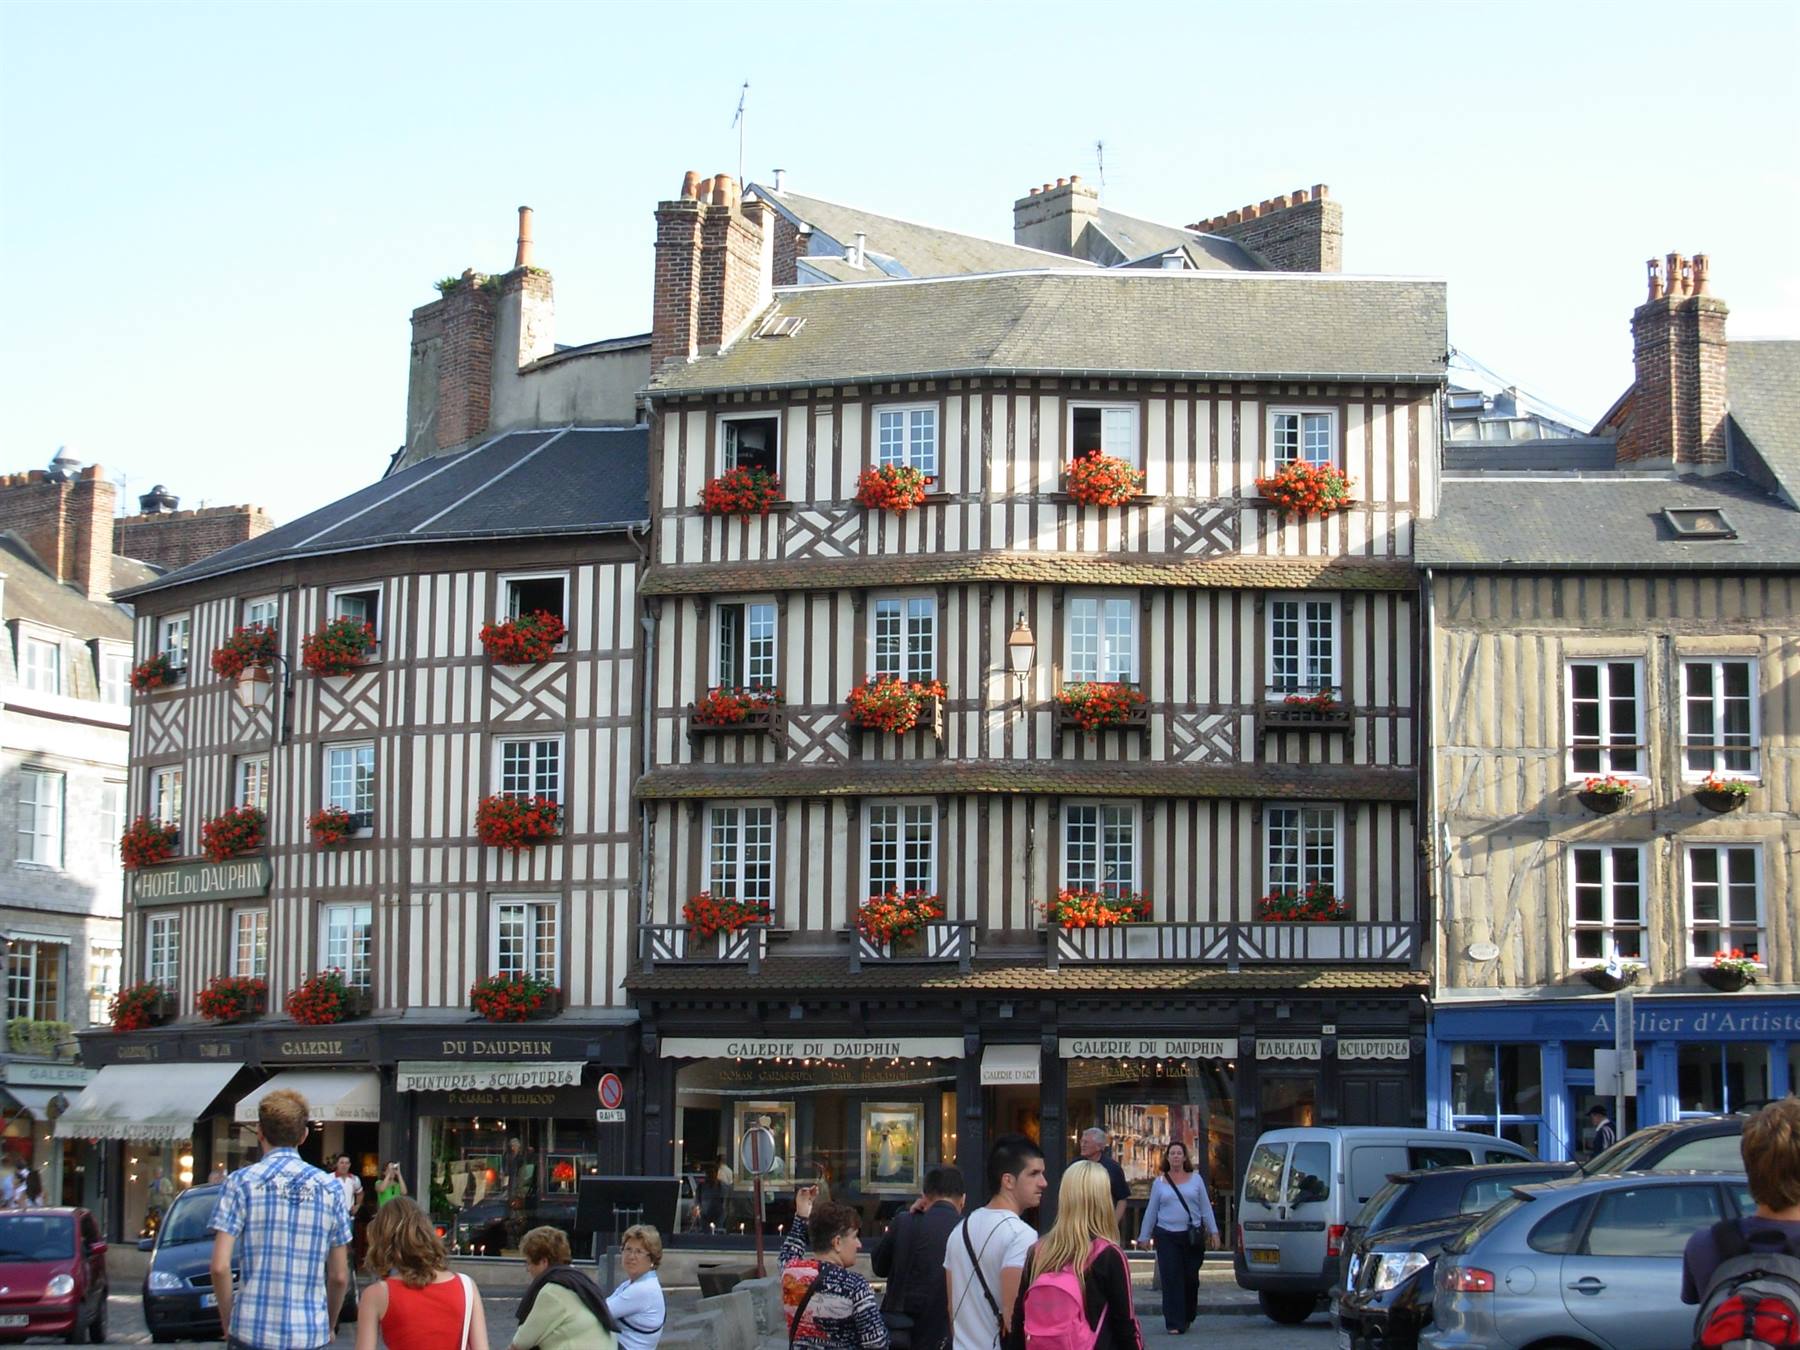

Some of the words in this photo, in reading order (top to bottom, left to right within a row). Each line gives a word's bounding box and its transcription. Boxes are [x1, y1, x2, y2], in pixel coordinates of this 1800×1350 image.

[141, 871, 183, 898] HOTEL
[184, 874, 200, 894] DU
[201, 863, 261, 892] DAUPHIN
[1591, 1011, 1684, 1032] Alier
[281, 1041, 343, 1056] GALERIE
[442, 1040, 468, 1055] DU
[472, 1040, 553, 1055] DAUPHIN
[727, 1043, 794, 1056] GALERIE
[803, 1043, 824, 1056] DU
[833, 1042, 900, 1056] DAUPHIN
[1072, 1041, 1132, 1054] GALERIE
[1139, 1041, 1157, 1054] DU
[1165, 1041, 1224, 1055] DAUPHIN
[1258, 1042, 1318, 1056] TABLEAUX
[1339, 1042, 1408, 1056] SCULPTURES
[29, 1068, 88, 1081] GALERIE
[406, 1075, 476, 1089] PEINTURES
[488, 1070, 574, 1086] SCULPTURES
[983, 1070, 1013, 1081] GALERIE
